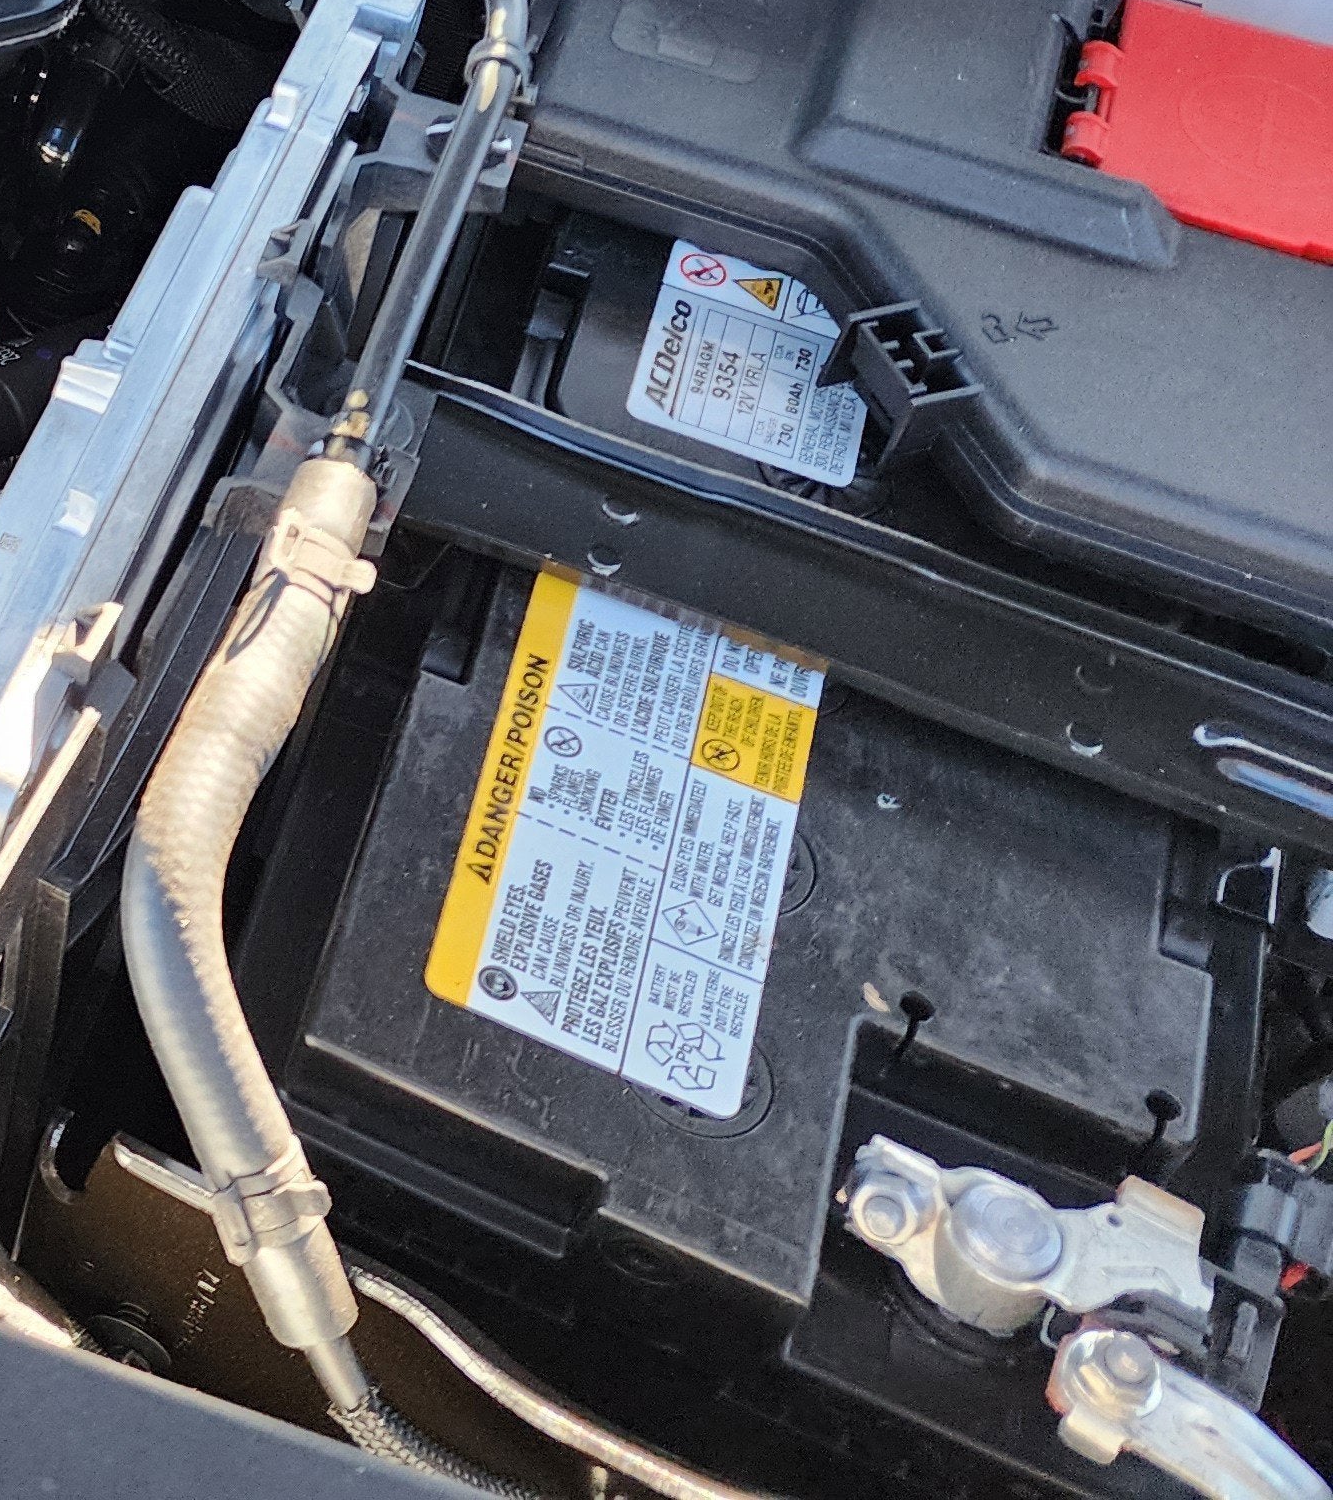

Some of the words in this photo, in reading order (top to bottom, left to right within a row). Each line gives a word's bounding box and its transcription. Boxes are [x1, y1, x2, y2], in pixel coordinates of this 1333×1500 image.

[646, 300, 692, 408] ACDelco
[691, 341, 715, 394] 94RAGM
[743, 352, 767, 388] VRLA
[795, 348, 813, 372] 730
[712, 351, 741, 400] 9354
[737, 390, 756, 415] 12V
[777, 423, 794, 448] 730
[568, 619, 595, 673] SULFURIC
[594, 630, 612, 651] CAN
[585, 651, 606, 680] ACID
[605, 631, 631, 687] BLINDNESS
[641, 632, 671, 696] SULFURIQUE
[669, 660, 686, 675] LA
[595, 687, 617, 721] CAUSE
[618, 672, 640, 712] SEVERE
[660, 674, 682, 716] CAUSER
[613, 711, 630, 728] OR
[653, 714, 673, 744] PEUT
[675, 712, 693, 734] DES
[476, 655, 548, 859] DANGER/POISON
[528, 786, 547, 805] NO
[639, 766, 663, 817] FLAMMES
[617, 810, 636, 832] LES
[634, 816, 652, 839] LES
[650, 827, 667, 845] DE
[613, 867, 638, 921] PEUVENT
[510, 902, 542, 972] EXPLOSIVE
[528, 860, 553, 902] GASES
[491, 919, 517, 965] SHIELD
[537, 915, 560, 955] CAUSE
[549, 923, 578, 989] BLINDNESS
[565, 904, 583, 923] OR
[530, 954, 550, 981] CAN
[578, 942, 599, 969] LES
[595, 920, 626, 990] EXPLOSIFS
[587, 989, 610, 1019] GAZ
[602, 998, 628, 1054] BLESSER
[619, 930, 644, 979] RENDRE
[581, 1018, 603, 1046] LES
[675, 1043, 693, 1064] Pb
